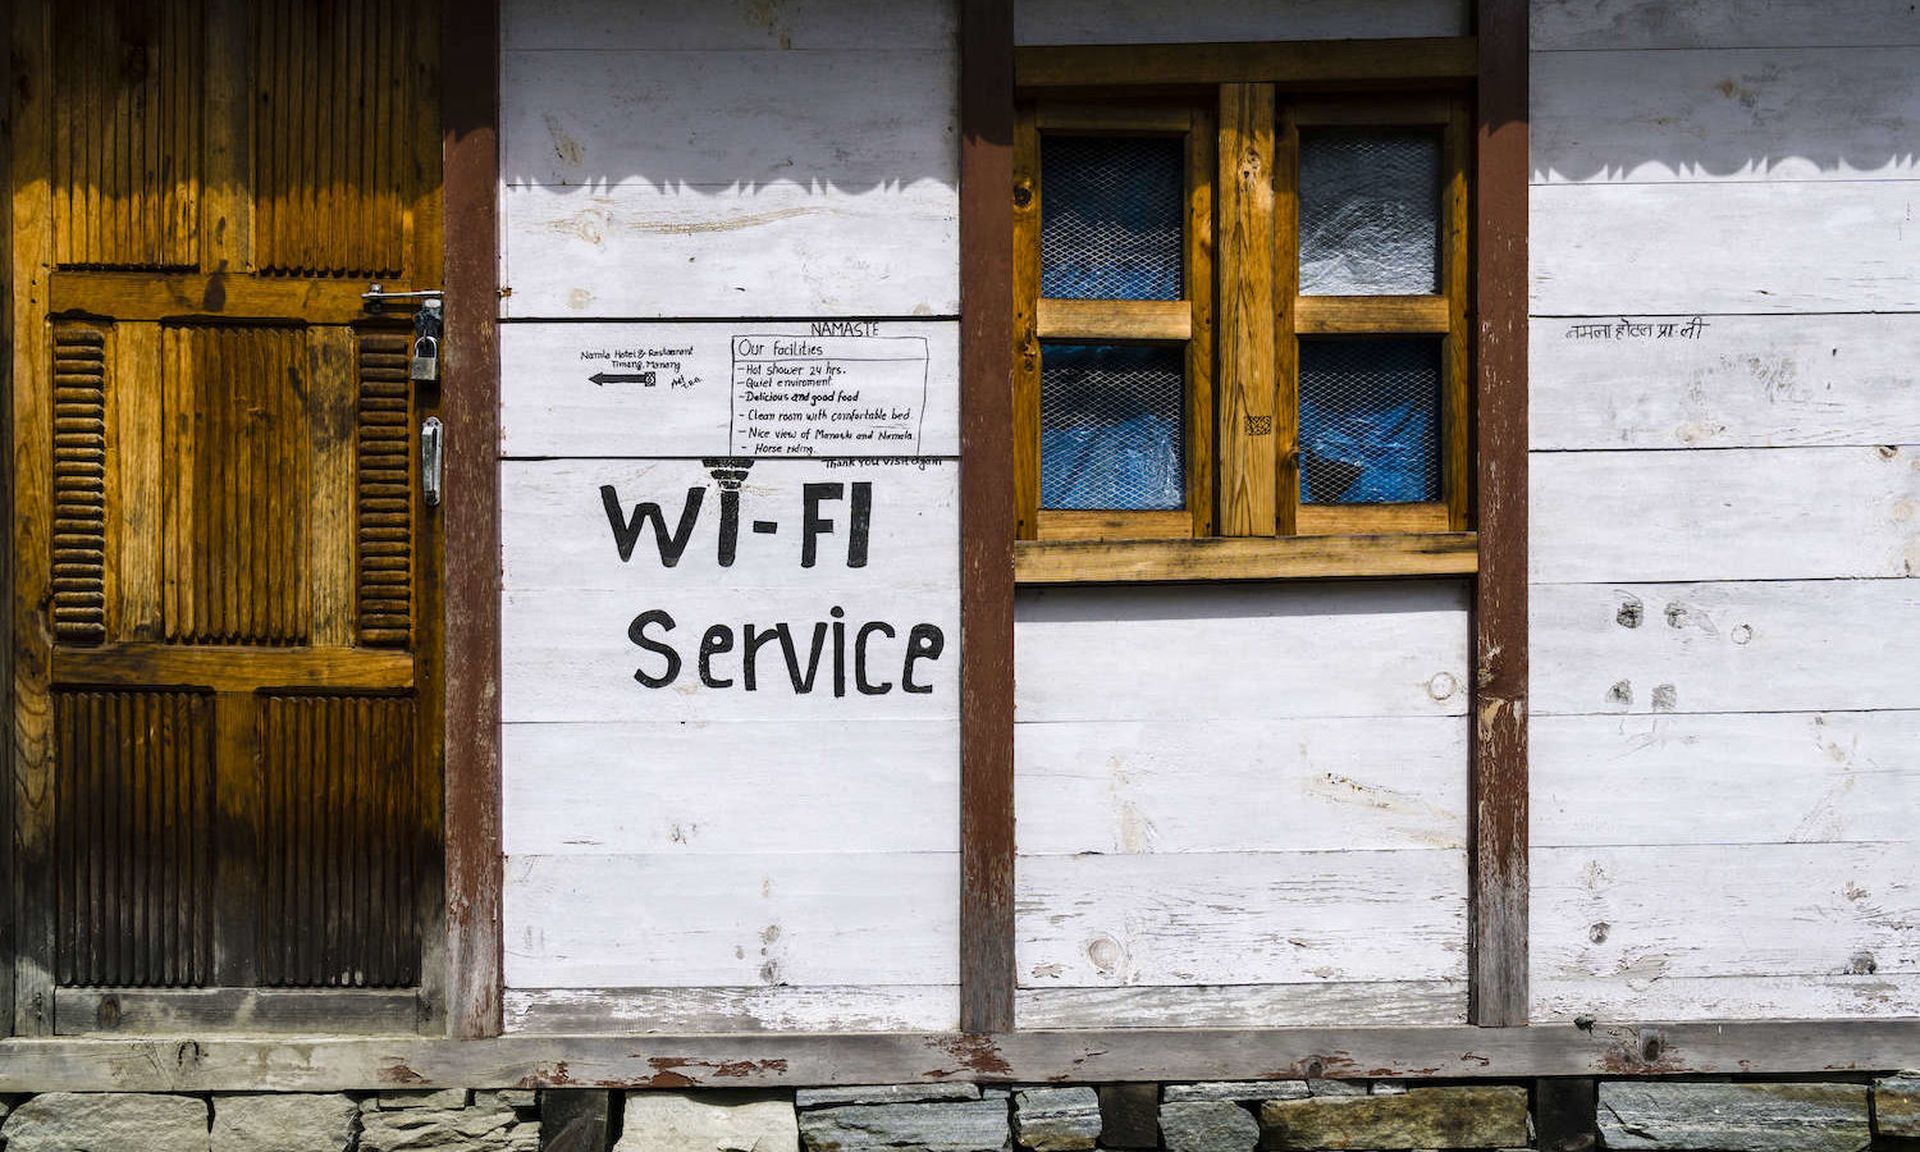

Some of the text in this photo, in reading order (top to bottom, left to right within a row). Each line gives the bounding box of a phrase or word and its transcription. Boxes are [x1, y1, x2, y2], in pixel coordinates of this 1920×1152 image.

[811, 323, 879, 337] NAMASTE
[614, 349, 636, 359] Hotel
[637, 349, 646, 359] &
[738, 339, 823, 356] Our facilities
[766, 362, 803, 376] shower
[809, 366, 822, 376] 24
[790, 392, 810, 402] and
[811, 391, 835, 407] good
[837, 390, 860, 403] food
[748, 410, 775, 421] Clean
[778, 411, 803, 421] room
[806, 408, 828, 420] with
[830, 408, 887, 422] comfortable
[749, 427, 771, 440] Nice
[774, 429, 797, 440] view
[800, 429, 811, 441] of
[855, 430, 874, 440] and
[754, 443, 783, 455] Horse
[823, 458, 856, 469] Thank
[627, 605, 945, 698] Service
